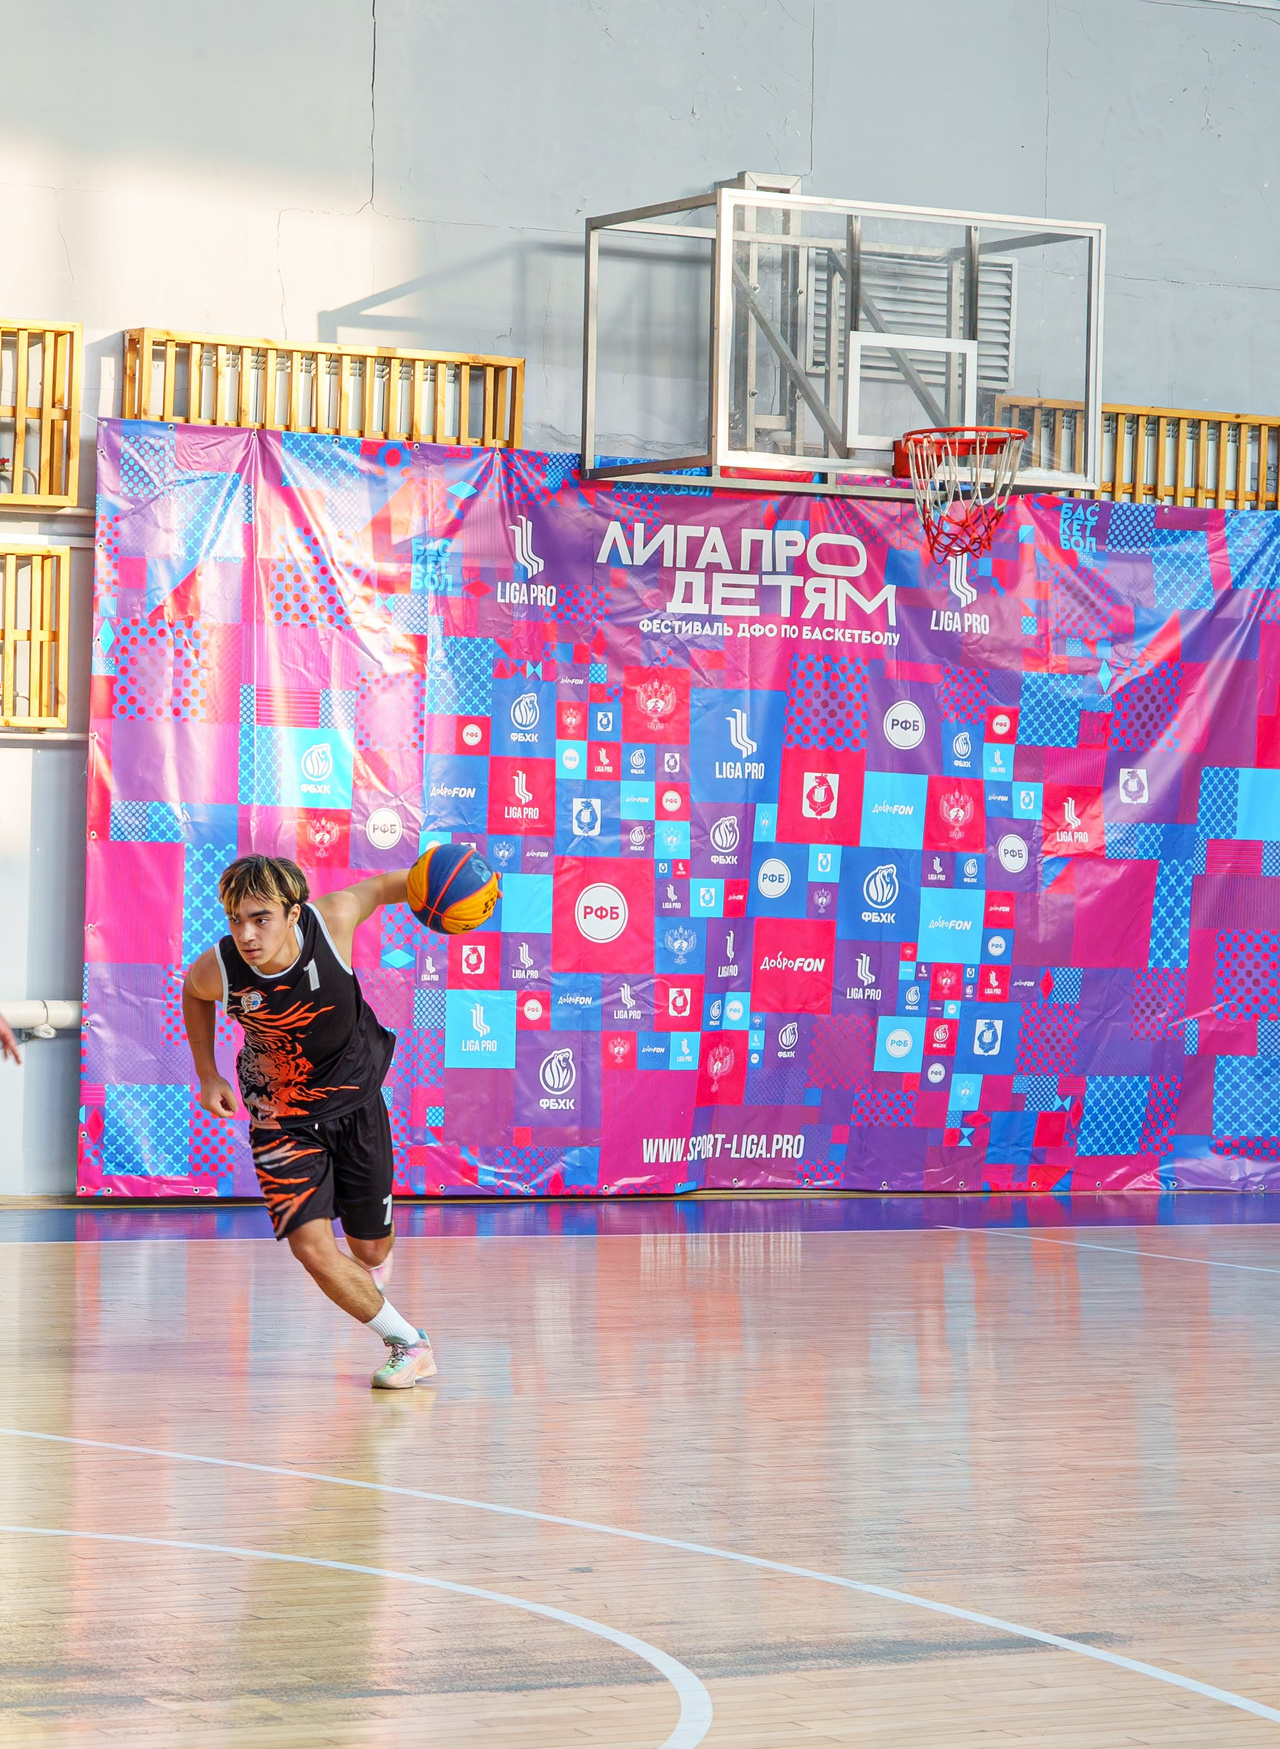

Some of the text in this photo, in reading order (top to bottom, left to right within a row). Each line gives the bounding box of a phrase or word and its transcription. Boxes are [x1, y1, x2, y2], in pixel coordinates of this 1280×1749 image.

[1060, 503, 1100, 520] БАС
[1060, 520, 1096, 536] КЕТ
[412, 538, 451, 557] БАС
[594, 520, 867, 578] ЛИГА ПРО
[1060, 538, 1096, 552] БОЛ
[412, 556, 449, 574] КЕТ
[412, 572, 452, 591] БОЛ
[497, 584, 556, 607] LIGA PRO
[667, 571, 896, 625] ДЕТЯМ
[930, 610, 990, 635] LIGA PRO
[639, 620, 900, 646] ФЕСТИВАЛЬ ДФО ПО БАСКЕТБОЛУ
[891, 719, 919, 732] РФБ
[510, 733, 538, 742] ФБХК
[716, 762, 764, 780] LIGA PRO
[301, 784, 330, 794] ФБХК
[430, 783, 476, 798] ДоброFON
[505, 807, 539, 819] LIGA PRO
[872, 801, 914, 815] ДоброFON
[373, 824, 396, 834] РФБ
[1057, 832, 1088, 842] LIGA PRO
[1004, 848, 1023, 858] РФБ
[711, 856, 737, 865] ФБХК
[762, 873, 784, 883] РФБ
[583, 906, 619, 920] РФБ
[862, 912, 895, 924] ФБХК
[929, 916, 971, 930] ДоброFON
[760, 952, 825, 972] ДоброFON
[303, 958, 320, 991] 1
[512, 970, 538, 978] LIGA PRO
[847, 988, 881, 1000] LIGA PRO
[614, 1010, 641, 1019] LIGA PRO
[462, 1040, 496, 1051] LIGA PRO
[890, 1039, 908, 1047] РФБ
[540, 1099, 575, 1109] ФБХК
[643, 1134, 804, 1162] WWW.SPORT-LIGA.PRO
[383, 1194, 392, 1225] 1
